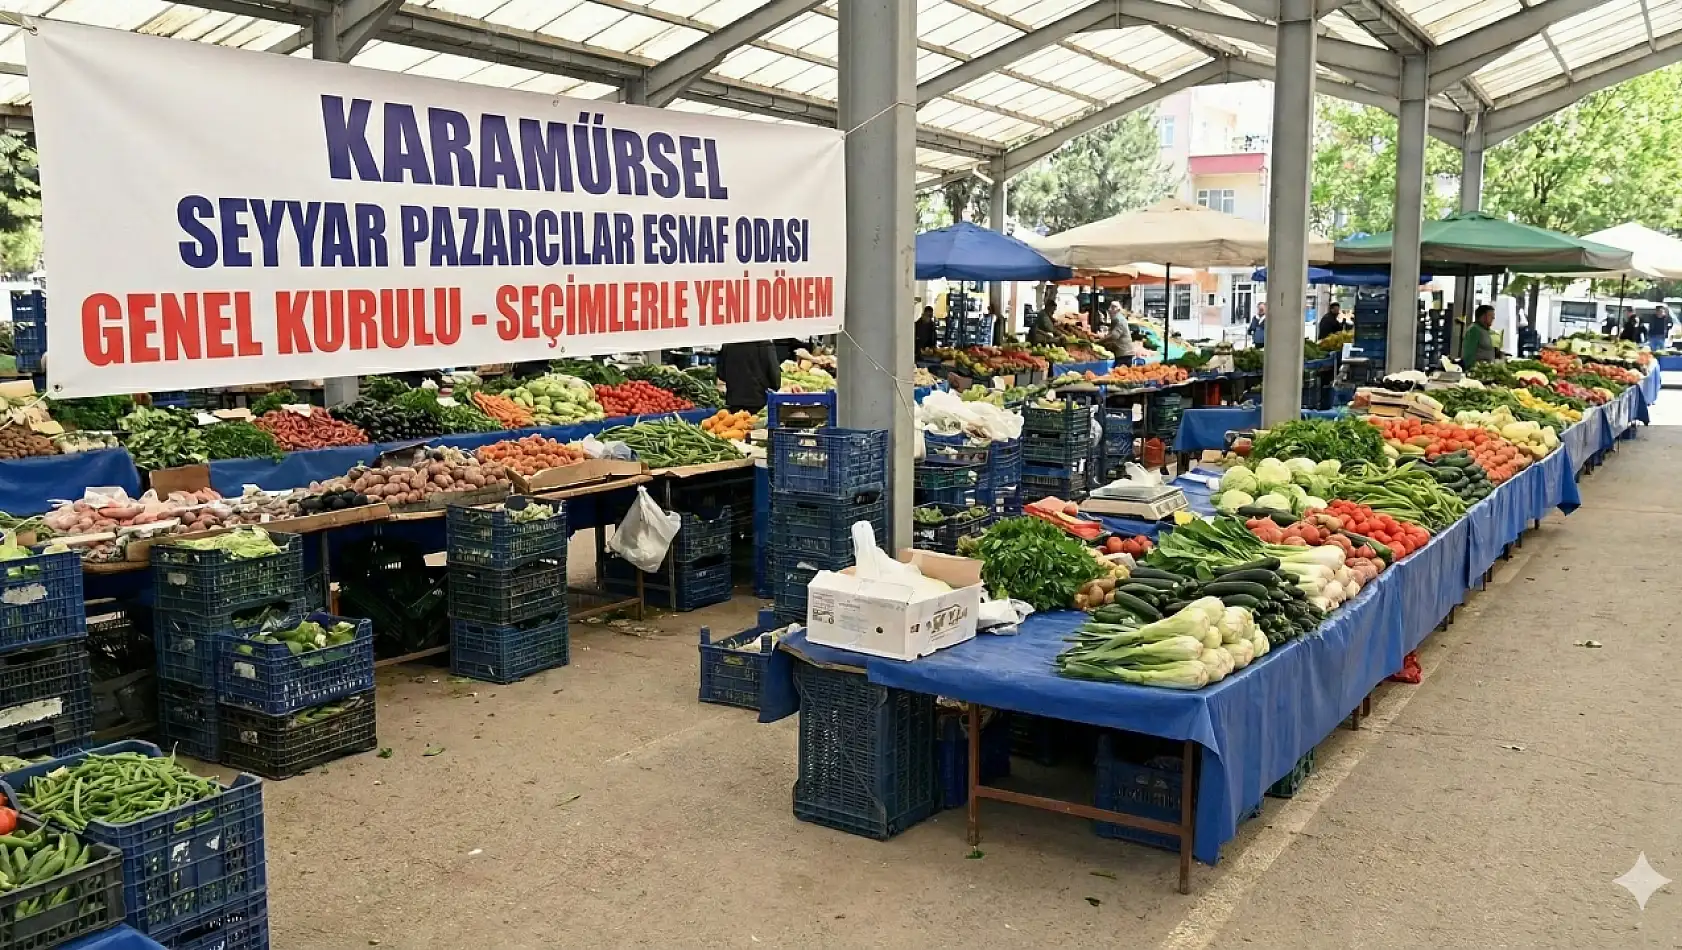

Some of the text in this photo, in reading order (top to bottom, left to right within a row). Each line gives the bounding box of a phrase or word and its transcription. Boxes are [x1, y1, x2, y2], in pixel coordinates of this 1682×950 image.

[321, 95, 728, 200] KARAMÜRSEL
[176, 194, 809, 268] SEYYAR PAZARCILAR ESNAF ODASI
[81, 269, 833, 368] GENEL KURULU - SEÇİMLERLE YENİ DÖNEM
